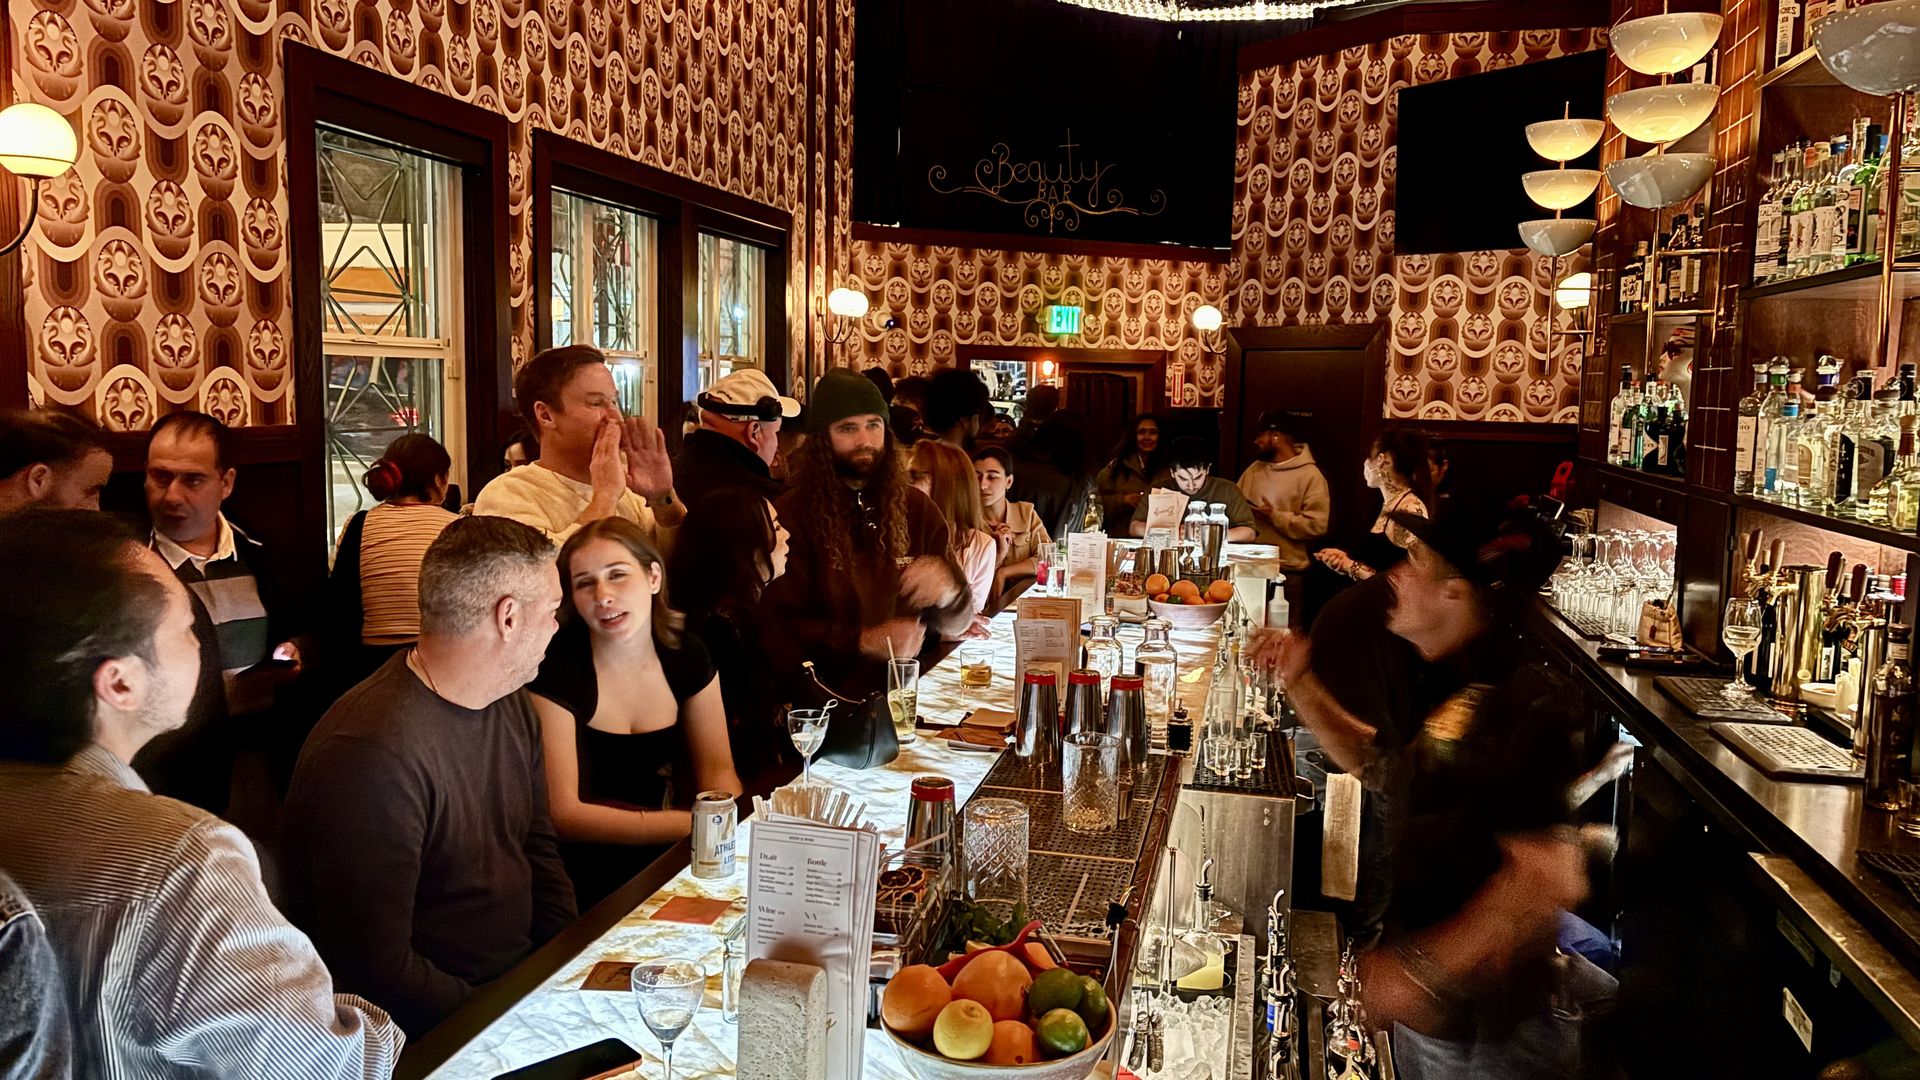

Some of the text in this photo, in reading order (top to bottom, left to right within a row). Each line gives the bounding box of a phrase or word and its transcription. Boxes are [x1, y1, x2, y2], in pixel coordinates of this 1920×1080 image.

[976, 128, 1116, 207] Beauty
[1038, 181, 1072, 202] BAR
[1052, 305, 1081, 334] EXIT
[758, 905, 777, 915] Wine
